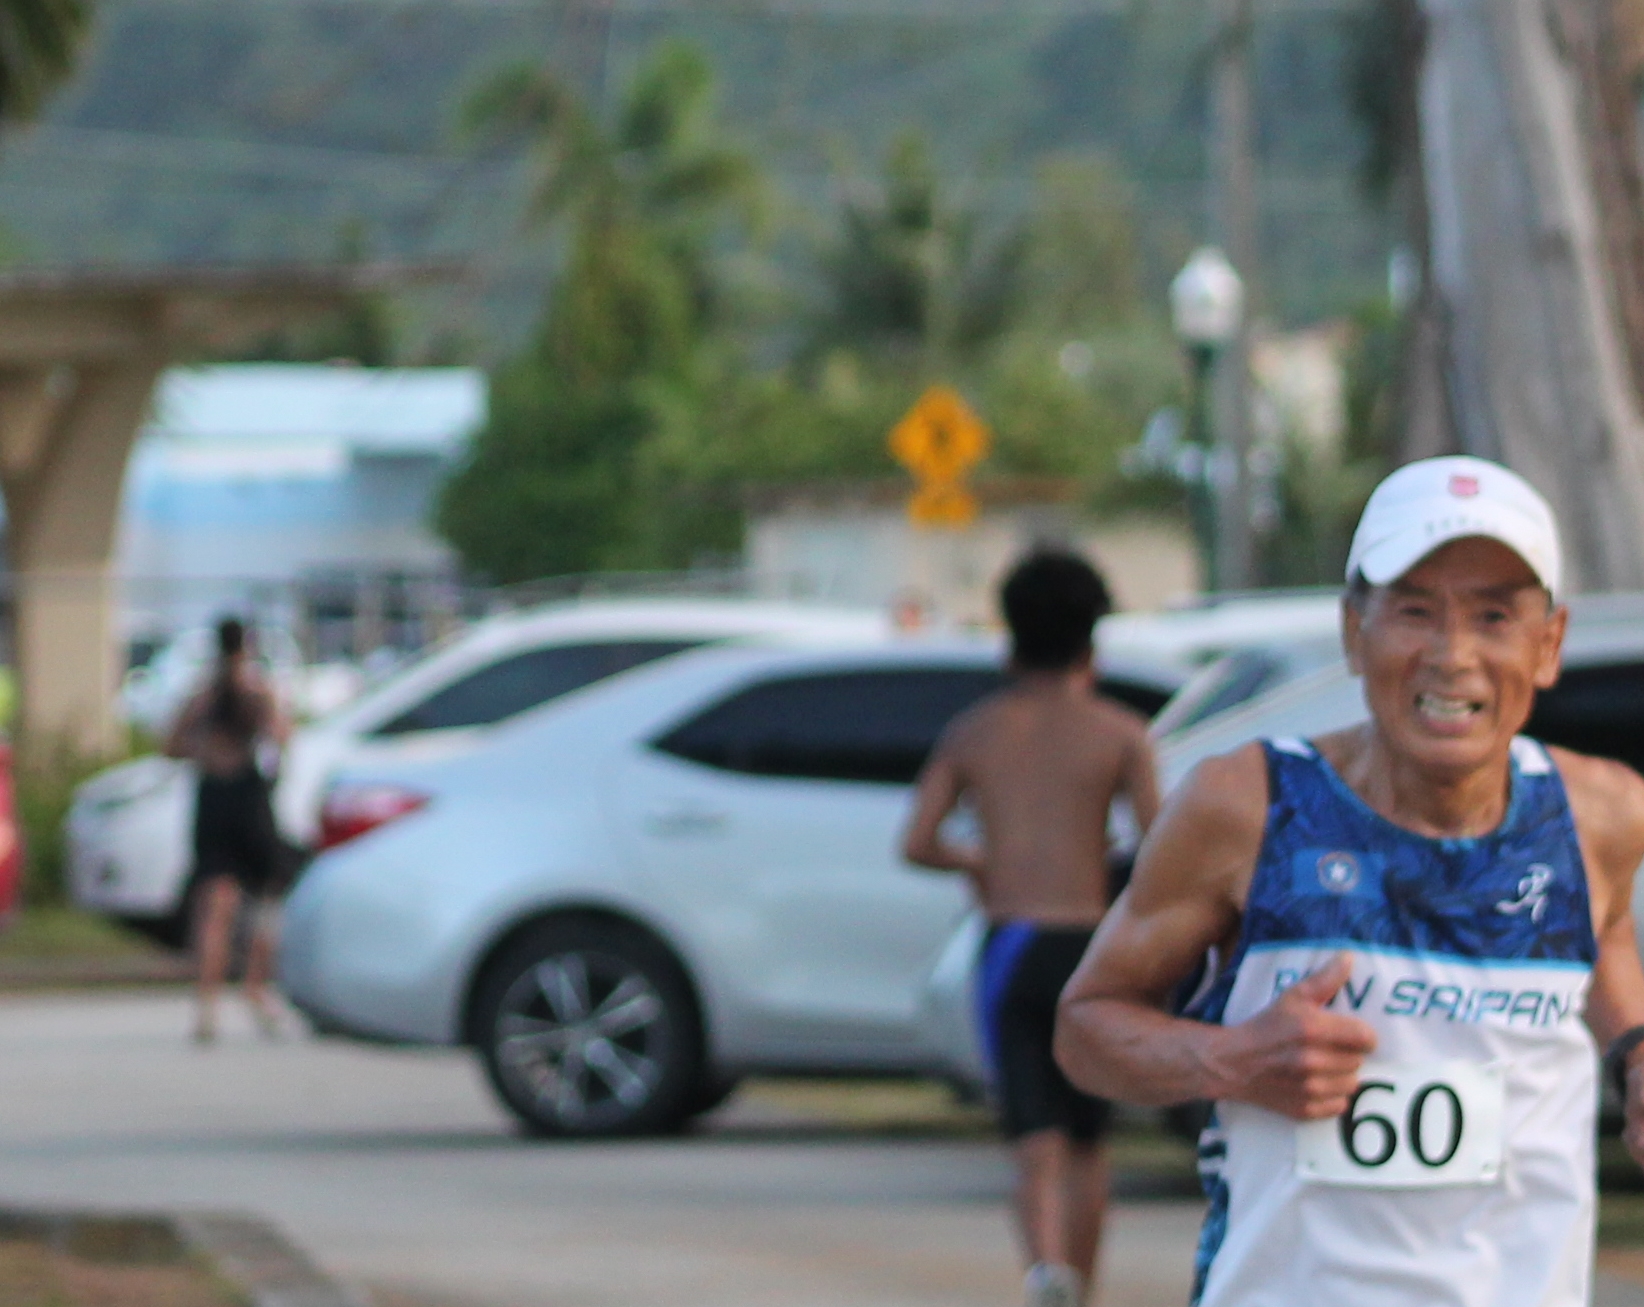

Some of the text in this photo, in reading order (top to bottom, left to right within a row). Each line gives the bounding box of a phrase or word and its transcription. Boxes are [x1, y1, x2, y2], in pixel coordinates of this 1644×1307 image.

[1275, 970, 1571, 1027] RN SAIPAN
[1341, 1082, 1464, 1167] 60
